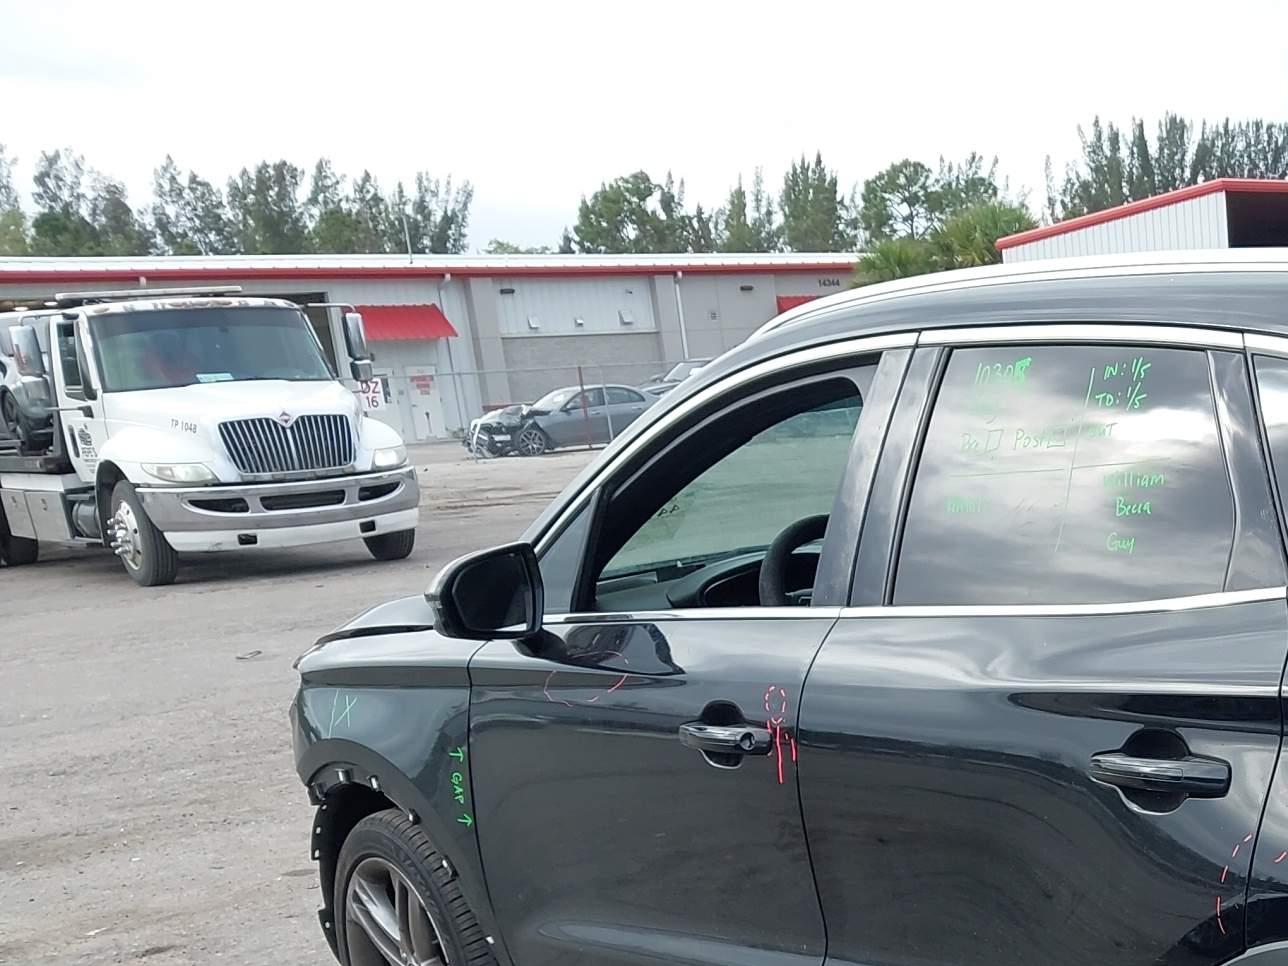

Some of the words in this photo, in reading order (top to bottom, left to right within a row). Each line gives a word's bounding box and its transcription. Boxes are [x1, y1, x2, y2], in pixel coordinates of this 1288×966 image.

[818, 279, 840, 287] 14344
[1132, 357, 1151, 381] 1/5
[366, 395, 379, 408] 16
[1127, 382, 1147, 411] 1/5
[450, 771, 465, 805] GAP
